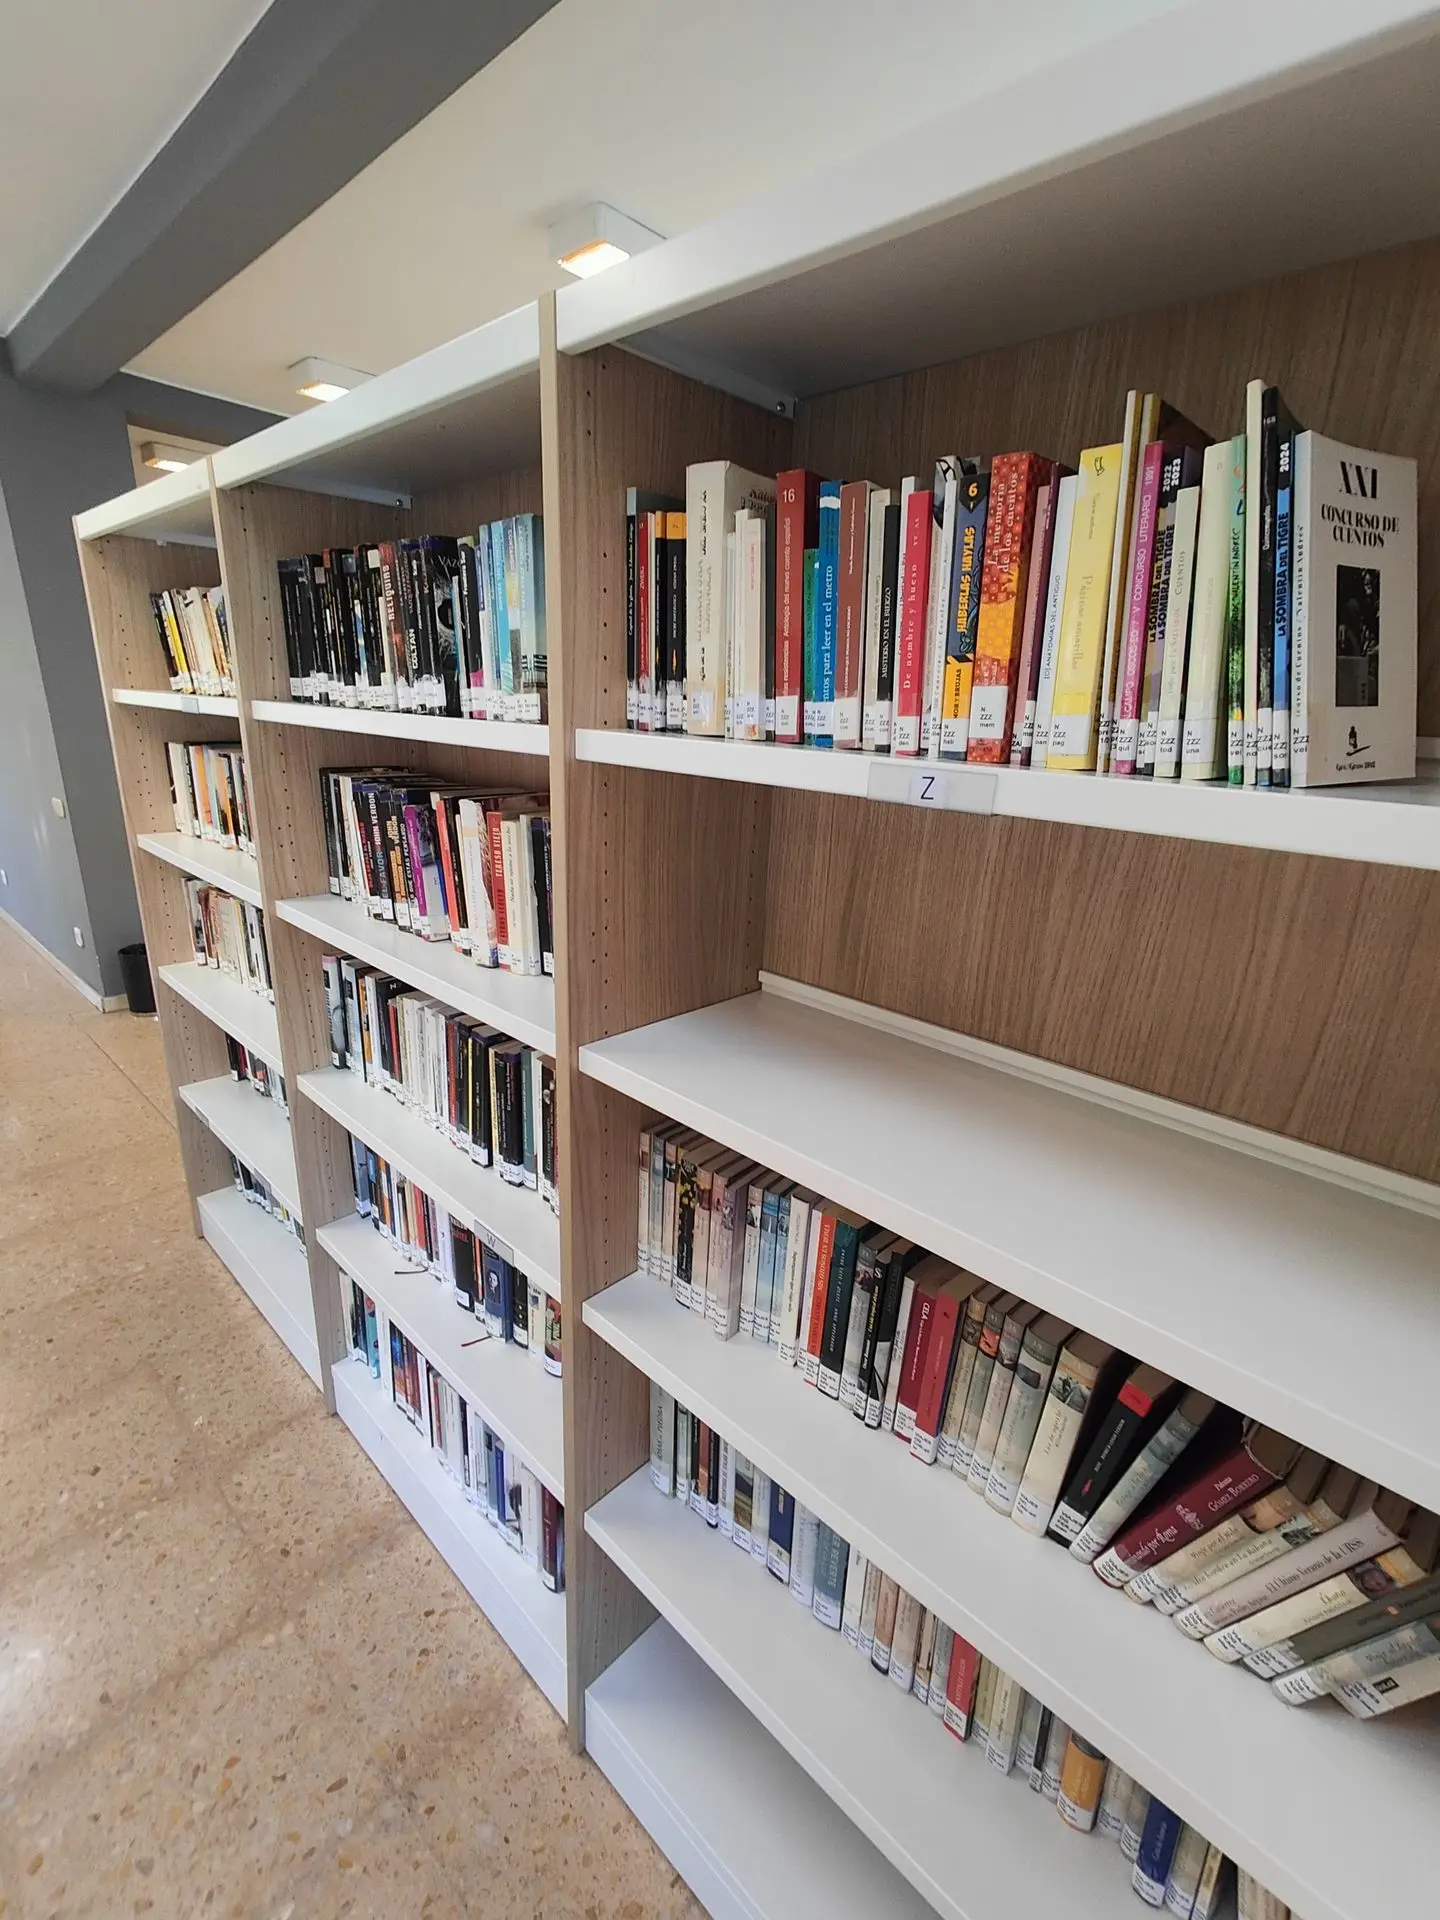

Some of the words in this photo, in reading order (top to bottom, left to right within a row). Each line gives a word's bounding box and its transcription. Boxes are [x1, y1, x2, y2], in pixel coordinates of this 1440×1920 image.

[1279, 442, 1290, 473] 2024
[1145, 465, 1155, 486] 1991
[1163, 465, 1172, 492] 2022
[1171, 458, 1181, 486] 2023
[1338, 461, 1378, 499] XXI
[782, 488, 795, 503] 16
[968, 482, 978, 497] 6
[1006, 472, 1018, 528] cuentos
[988, 550, 998, 566] La
[993, 483, 1005, 545] memoria
[1140, 494, 1152, 543] LITERARIO
[1278, 511, 1289, 547] TIGRE
[1321, 503, 1380, 531] CONCURSO
[1382, 515, 1400, 534] DE
[1000, 532, 1012, 553] los
[1156, 530, 1166, 560] TIGRE
[1164, 524, 1175, 559] TIGRE
[1333, 524, 1385, 548] CUENTOS
[962, 526, 976, 572] HAYLAS
[1279, 549, 1288, 569] DEL
[998, 557, 1011, 573] de
[1133, 548, 1147, 601] CONCURSO
[1154, 561, 1162, 580] DEL
[1161, 560, 1172, 578] DEL
[825, 565, 833, 599] metro
[908, 564, 917, 602] hueso
[824, 601, 832, 612] el
[957, 574, 971, 633] HABERLAS
[1149, 580, 1161, 632] SOMBRA
[1157, 579, 1170, 630] SOMBRA
[1276, 570, 1288, 624] SOMBRA
[824, 614, 832, 628] en
[883, 627, 890, 640] EN
[1278, 624, 1287, 637] LA
[823, 629, 832, 650] leer
[906, 620, 915, 667] nombre
[1149, 631, 1156, 642] LA
[1158, 630, 1166, 640] LA
[408, 628, 419, 669] COLTAN
[881, 640, 890, 678] MISTERIO
[822, 652, 833, 675] para
[903, 672, 912, 689] De
[1293, 727, 1299, 735] N
[920, 776, 935, 800] Z
[367, 792, 379, 825] VERDON
[372, 825, 382, 846] JOHN
[486, 1232, 496, 1248] W
[920, 1302, 931, 1321] CELA
[1207, 1492, 1231, 1512] GÓMEZ
[1228, 1473, 1259, 1497] BORRERO
[1155, 1525, 1178, 1543] Roma
